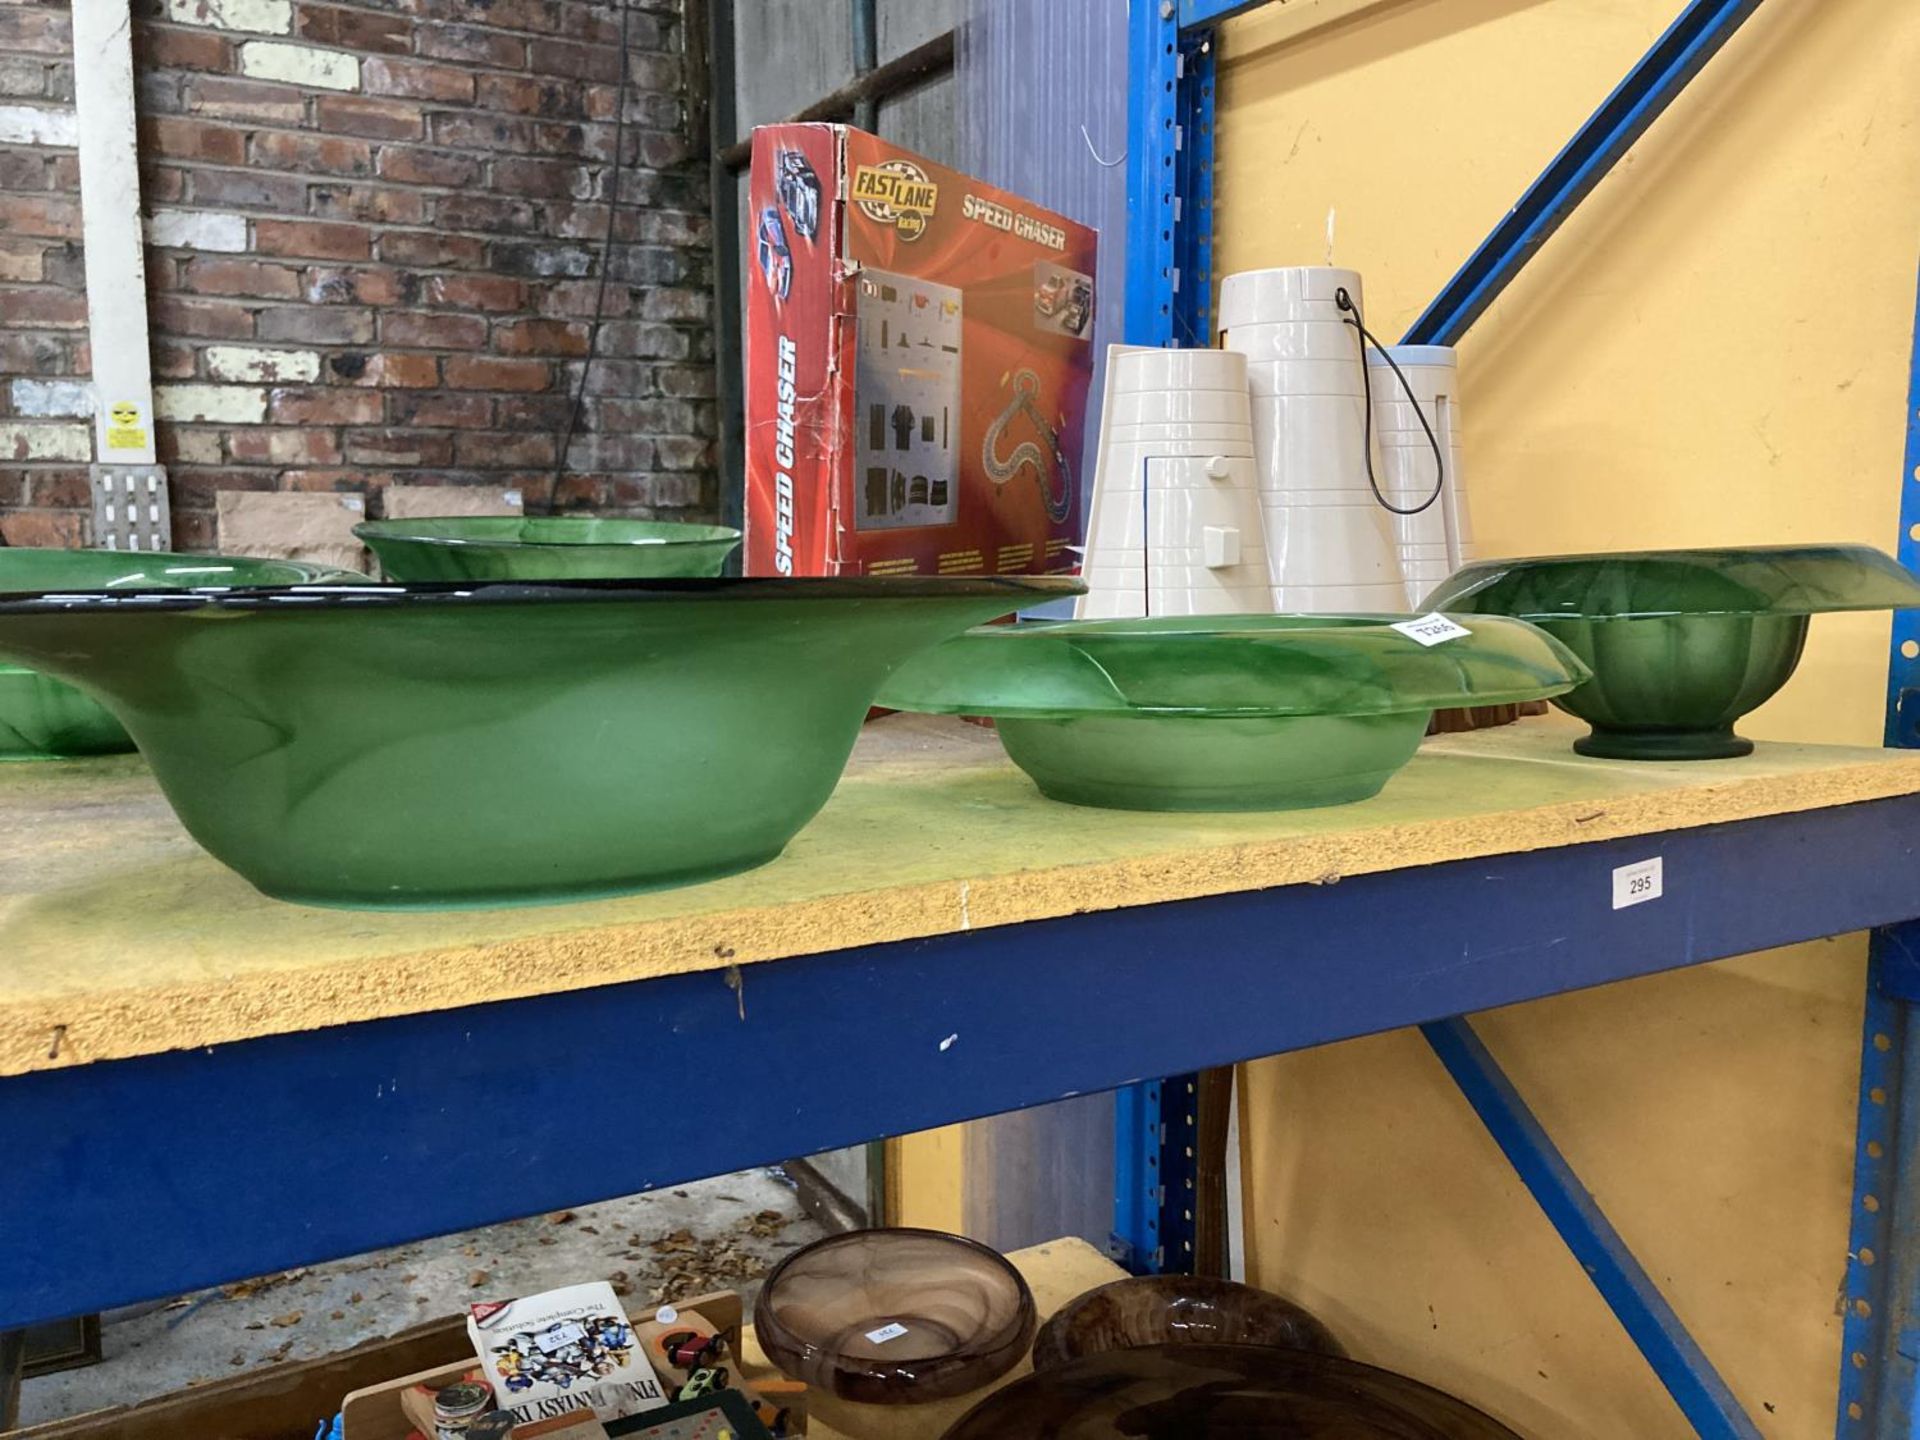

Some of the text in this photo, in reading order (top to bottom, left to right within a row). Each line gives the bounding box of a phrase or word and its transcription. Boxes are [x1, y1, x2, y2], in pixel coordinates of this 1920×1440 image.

[962, 193, 1066, 251] SPEED CHASER
[775, 335, 797, 577] SPEED CHASER
[1630, 876, 1652, 894] 295
[493, 1302, 607, 1334] The Complete Solution
